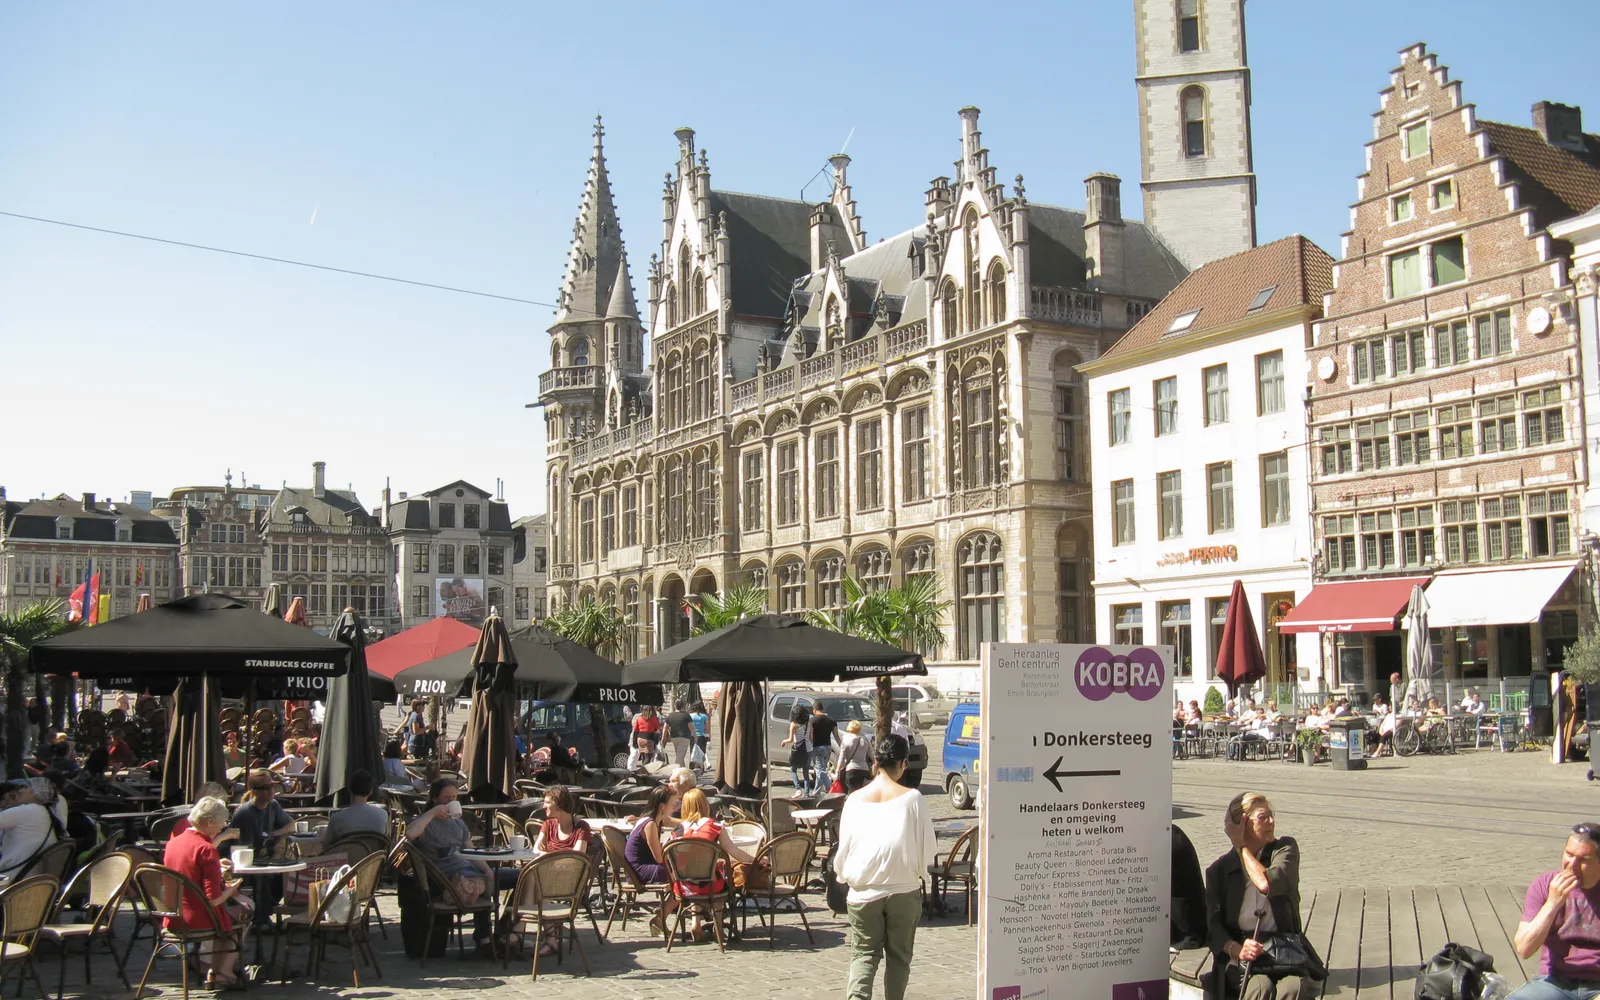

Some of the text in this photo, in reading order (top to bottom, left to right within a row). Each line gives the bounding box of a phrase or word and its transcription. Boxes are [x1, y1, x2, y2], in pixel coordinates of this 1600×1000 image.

[1189, 545, 1238, 562] PEKING
[1013, 649, 1060, 660] Heraanleg
[245, 660, 299, 668] STARBUCKS
[998, 659, 1060, 669] Gent centrum
[1079, 662, 1161, 687] KOBRA
[414, 680, 446, 694] PRIOR
[600, 688, 637, 702] PRIOR
[1044, 731, 1152, 748] Donkersteeg
[1019, 800, 1145, 813] Handelaars Donkersteeg
[1050, 814, 1116, 825] en omgeving
[1042, 828, 1071, 837] heten
[1085, 826, 1124, 835] welkom
[1027, 846, 1137, 859] Aroma Restaurant Burata Bis
[1015, 855, 1149, 871] Beauty Queen Blondeel Lederwaren
[1014, 871, 1050, 881] Carrefour
[1052, 870, 1080, 880] Express
[1088, 868, 1116, 877] Chinees
[1129, 866, 1149, 874] Lotus
[1020, 883, 1045, 892] Dolly's
[1053, 880, 1104, 889] Etablissement
[1127, 876, 1143, 884] Fritz
[1058, 890, 1080, 899] Koffie
[1128, 886, 1149, 894] Draak
[1029, 903, 1052, 911] Ocean
[1060, 900, 1090, 909] Mayouly
[1092, 898, 1118, 907] Boetiek
[1125, 896, 1157, 904] Mokabon
[1000, 905, 1161, 924] Monsoon Novotel Hotels Petite Normandie
[1003, 923, 1072, 935] Pannenkoekenhuis
[1074, 920, 1105, 930] Gwenola
[1018, 926, 1144, 944] Van Acker R. Restaurant De Kruik
[1018, 945, 1043, 956] Saigon
[1045, 944, 1065, 954] Shop
[1102, 936, 1144, 948] Zwaenepoel
[1021, 955, 1045, 965] Soirée
[1081, 949, 1116, 959] Starbucks
[1118, 947, 1140, 956] Coffee
[1029, 958, 1133, 974] Trio's Van Bignoot Jewellers
